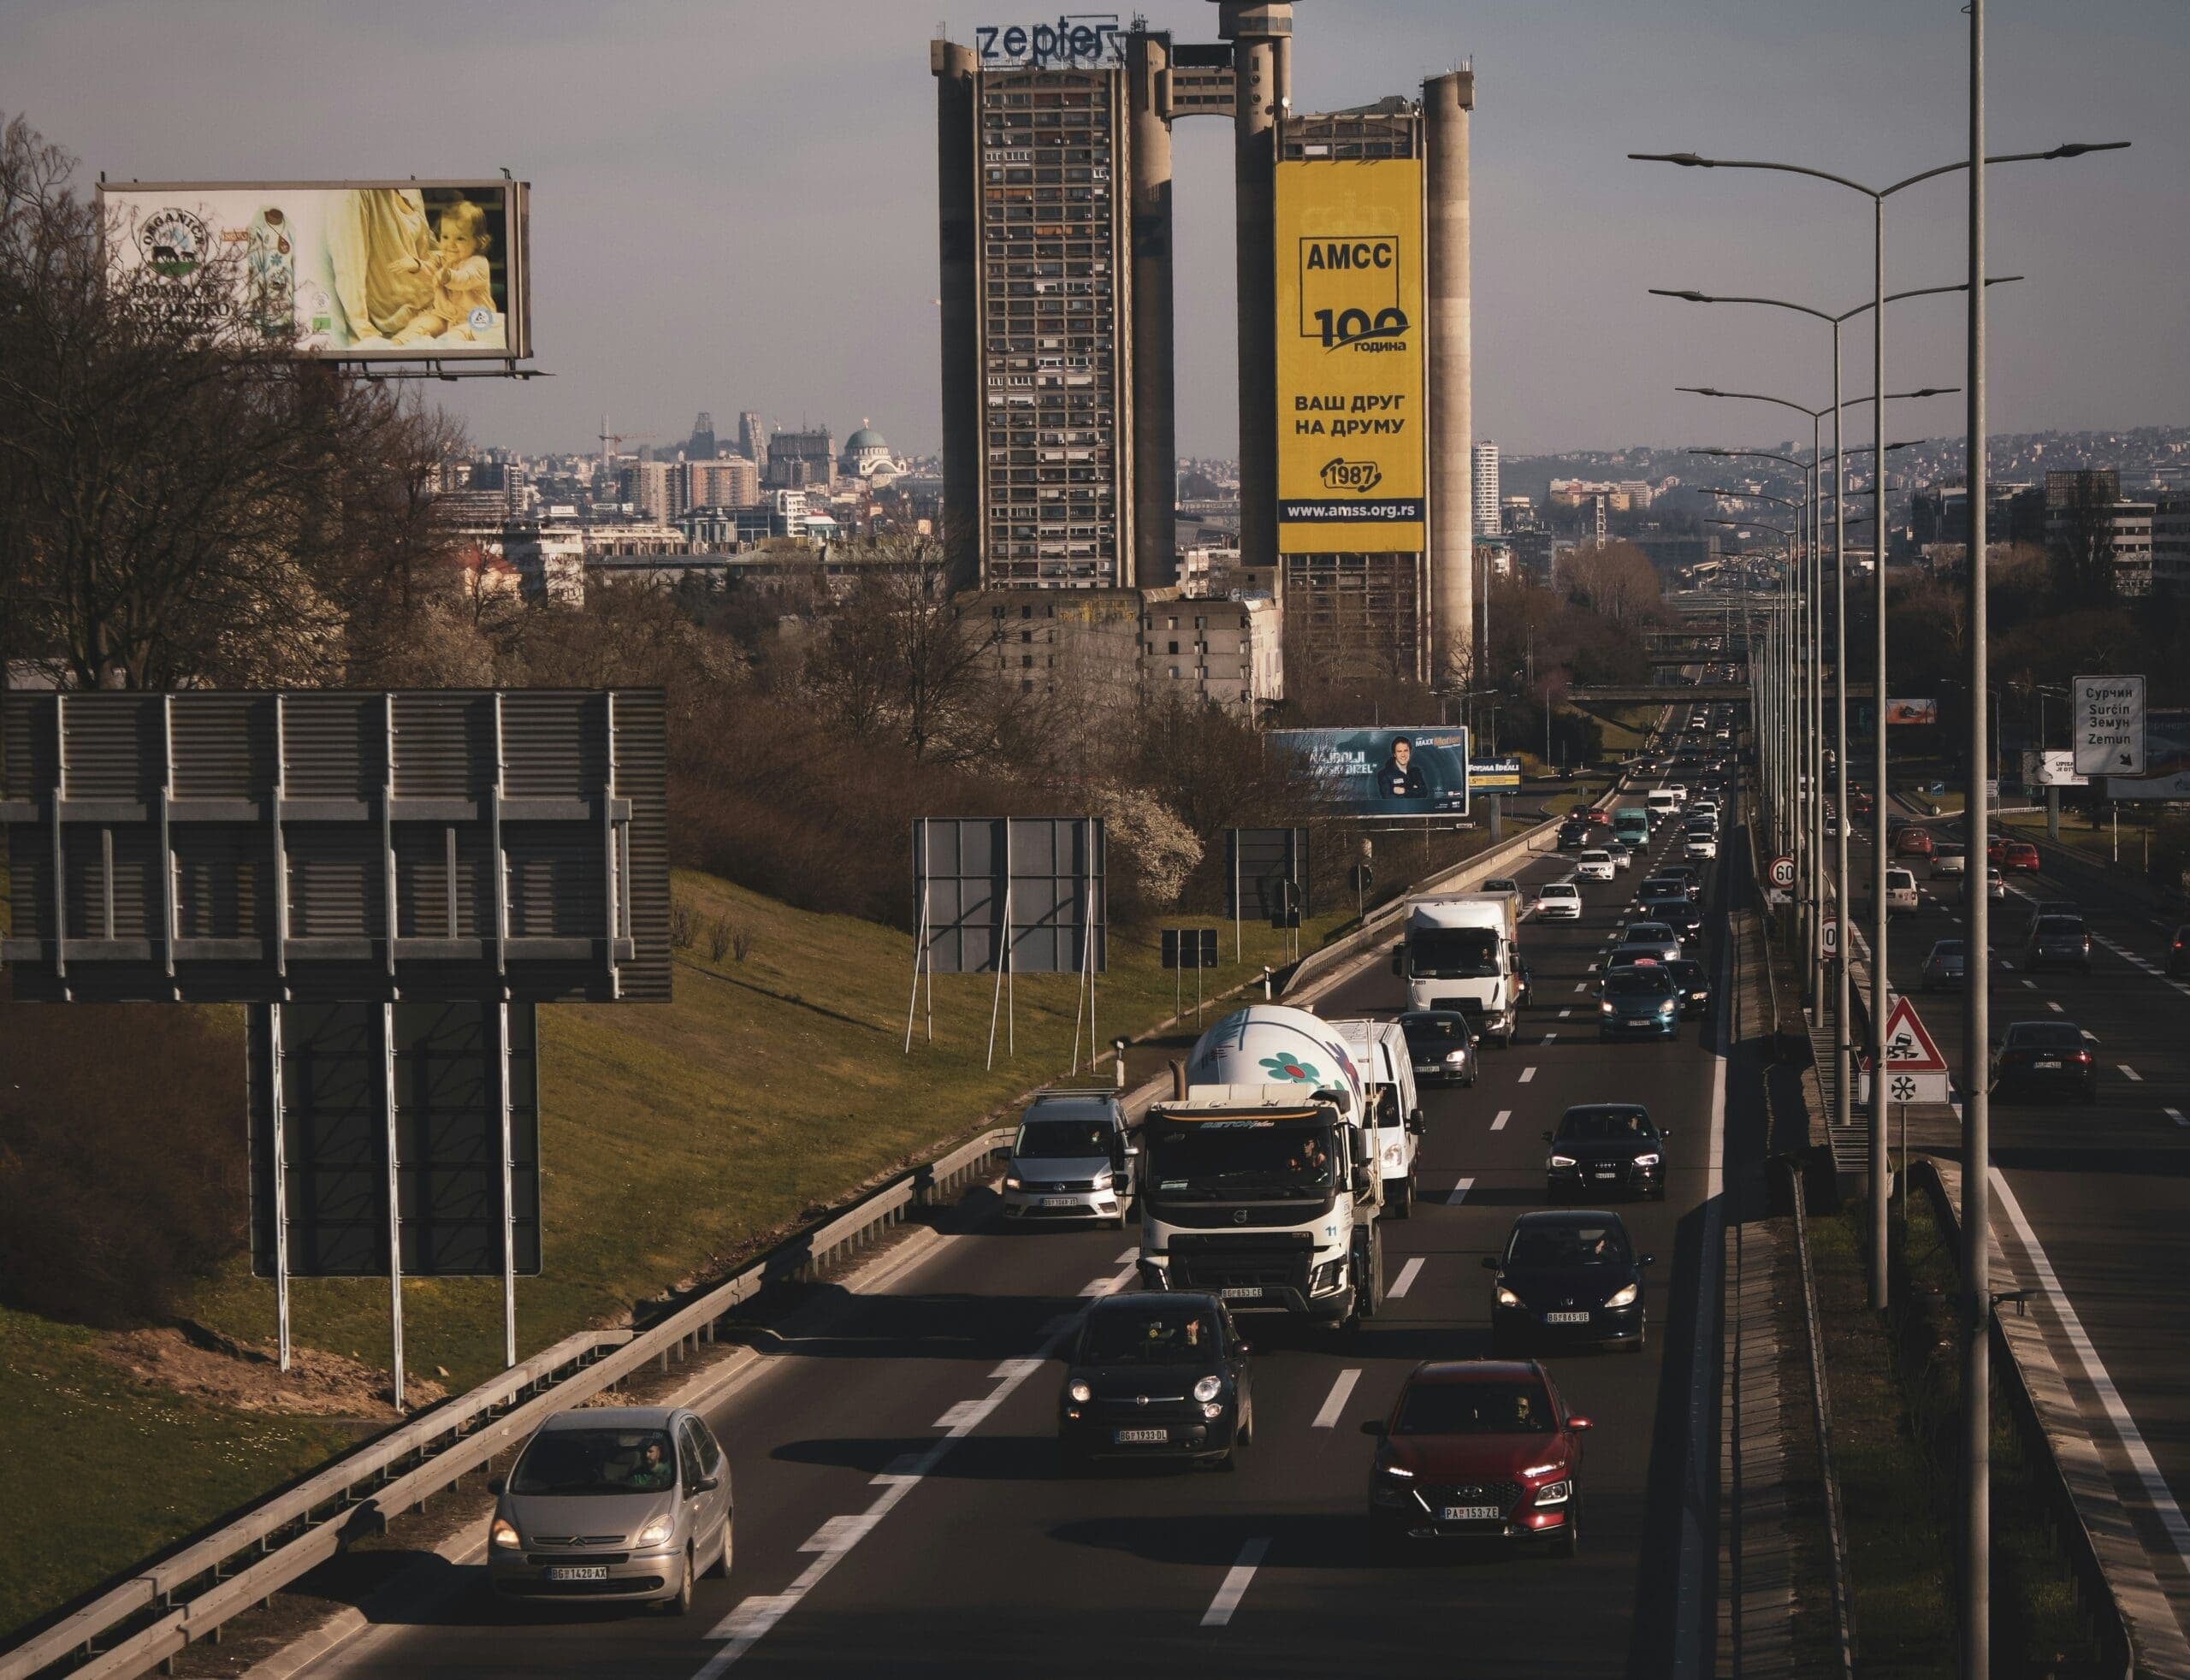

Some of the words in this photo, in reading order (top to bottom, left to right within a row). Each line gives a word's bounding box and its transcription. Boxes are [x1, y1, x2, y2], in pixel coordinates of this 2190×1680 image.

[976, 15, 1118, 67] zepter
[1314, 308, 1408, 347] 100
[1354, 341, 1406, 352] година
[1295, 396, 1345, 411] ВАШ
[1351, 395, 1405, 413] ДРУГ
[1296, 420, 1325, 435] НА
[1331, 419, 1405, 437] ДРУМУ
[1329, 466, 1374, 484] 1987
[1287, 506, 1415, 518] www.amss.org.rs
[2086, 688, 2133, 700] Сурчин
[2089, 704, 2129, 715] Surčin
[2090, 717, 2129, 730] Земун
[2088, 734, 2131, 744] Zemun
[1776, 866, 1793, 880] 60
[1325, 1226, 1336, 1236] 11
[1121, 1432, 1130, 1440] BG
[1447, 1509, 1458, 1517] PA
[1466, 1508, 1497, 1517] 153-ZE
[553, 1569, 563, 1578] BG
